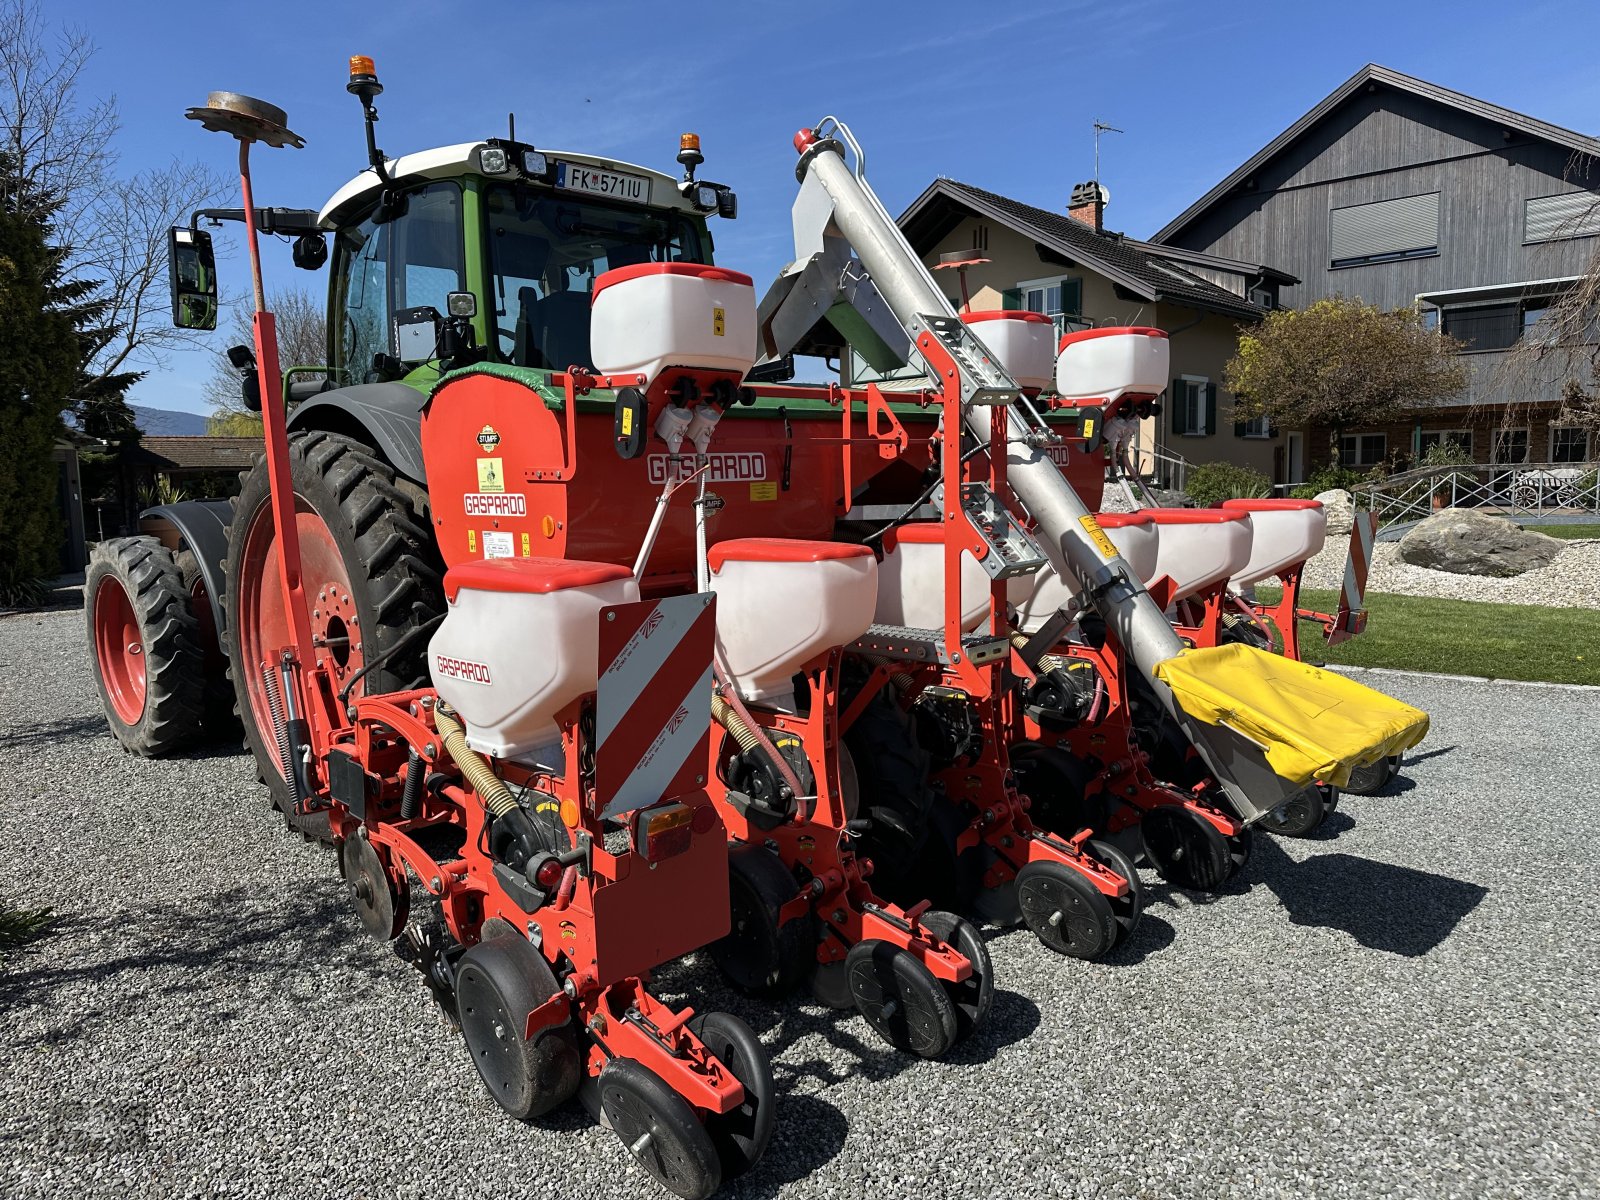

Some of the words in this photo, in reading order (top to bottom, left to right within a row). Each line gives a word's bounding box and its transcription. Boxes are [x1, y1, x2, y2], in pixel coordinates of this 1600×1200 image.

[571, 168, 590, 189] FK
[479, 434, 498, 443] STUMPF
[650, 454, 765, 482] GSARDO
[464, 495, 526, 515] GASPARDO
[437, 655, 491, 684] GASPARDO
